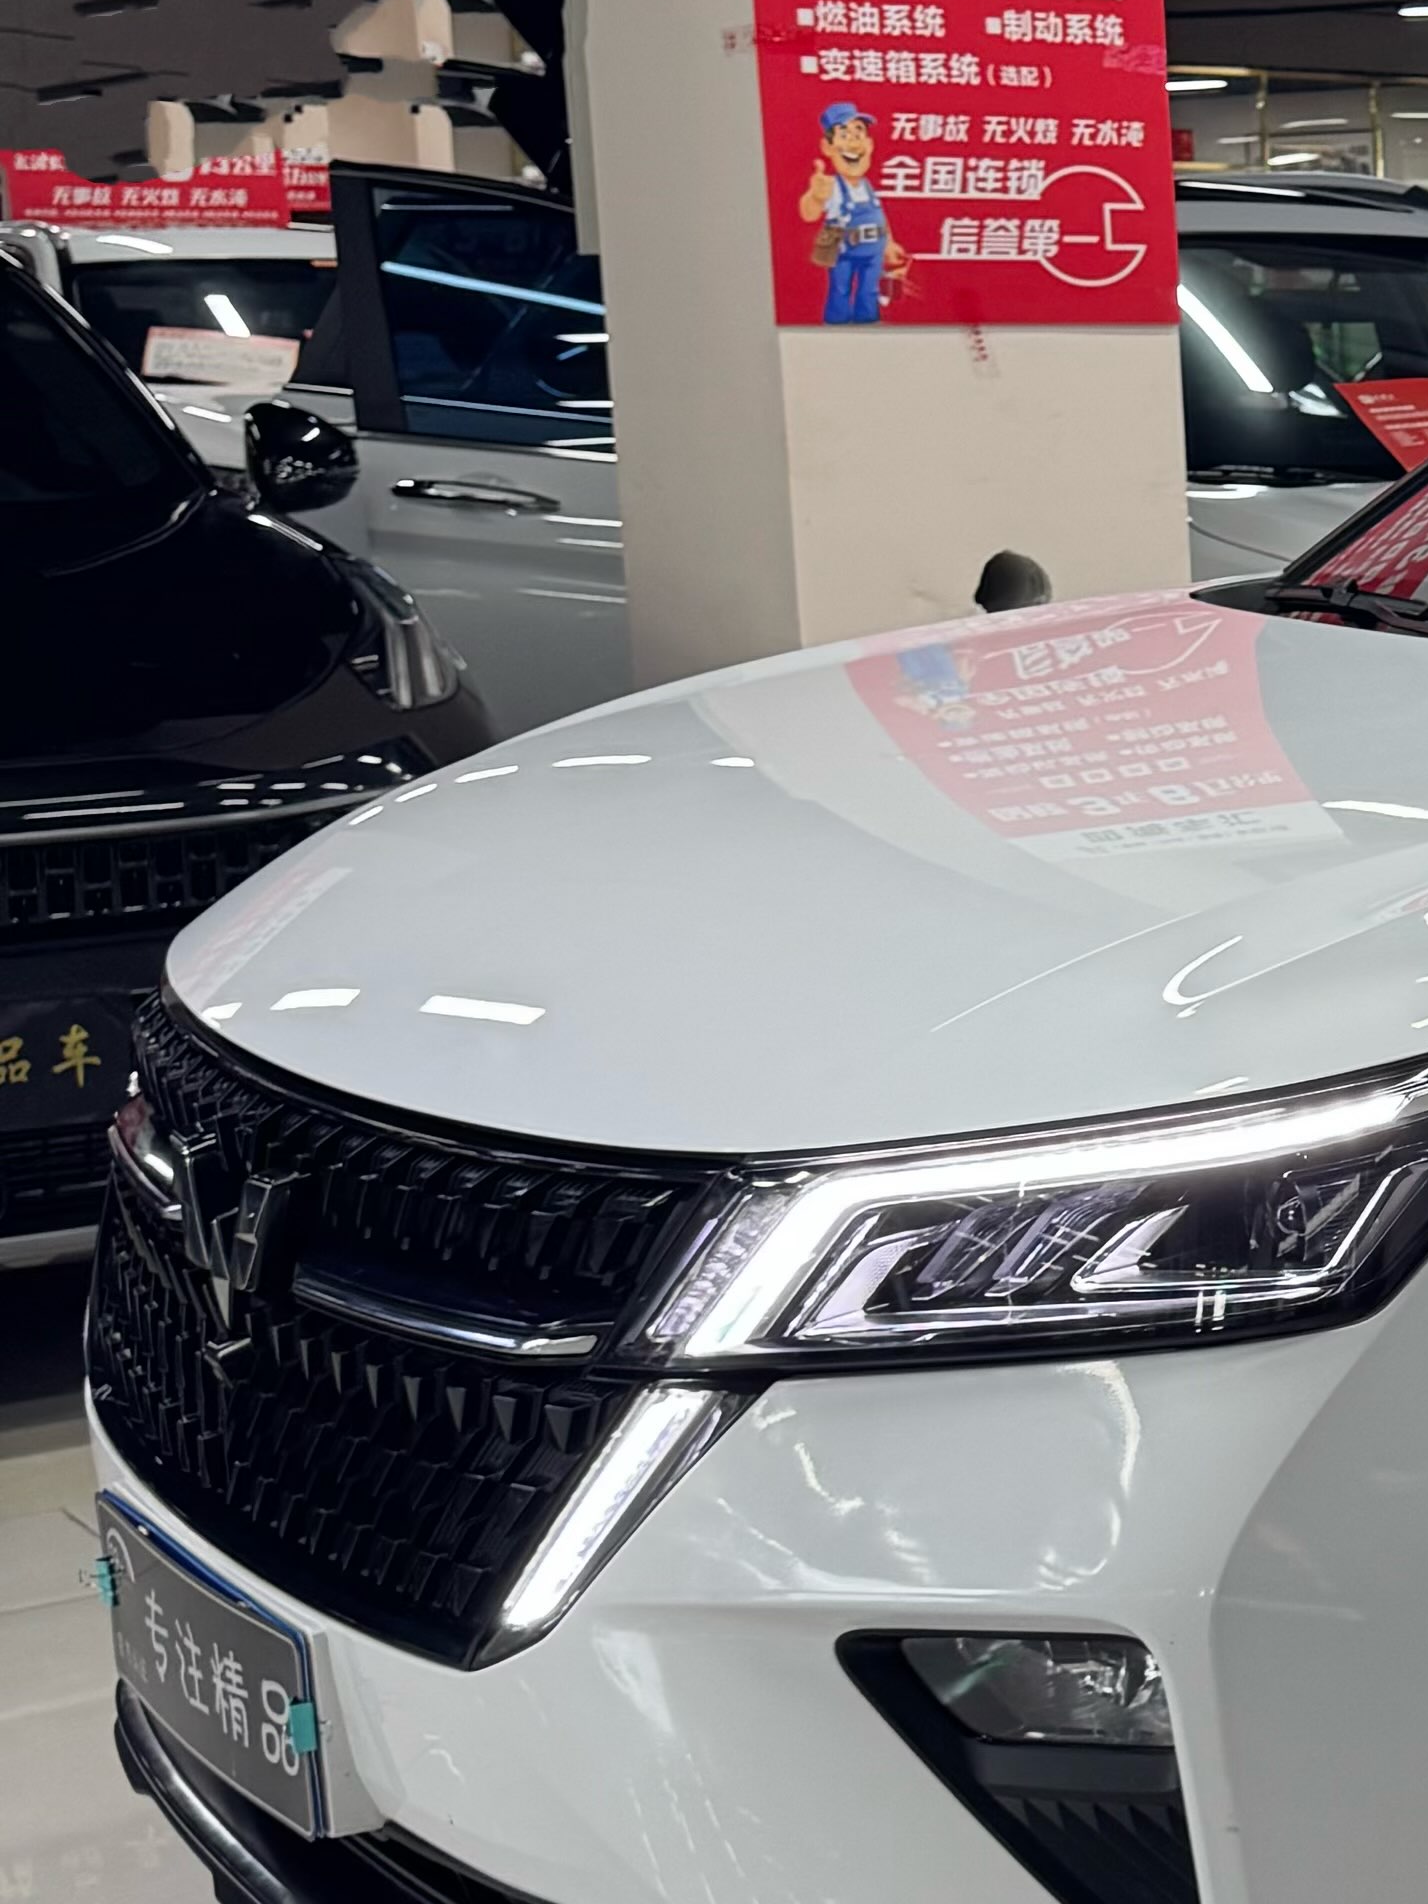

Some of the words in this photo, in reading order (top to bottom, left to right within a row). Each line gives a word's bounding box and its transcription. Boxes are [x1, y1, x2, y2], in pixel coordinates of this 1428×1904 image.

[815, 0, 946, 38] 燃油系统
[1003, 9, 1126, 46] 制动系统
[881, 155, 1046, 199] 全国连锁
[939, 217, 1101, 260] 信誉第一
[144, 1588, 300, 1778] 专注精品
